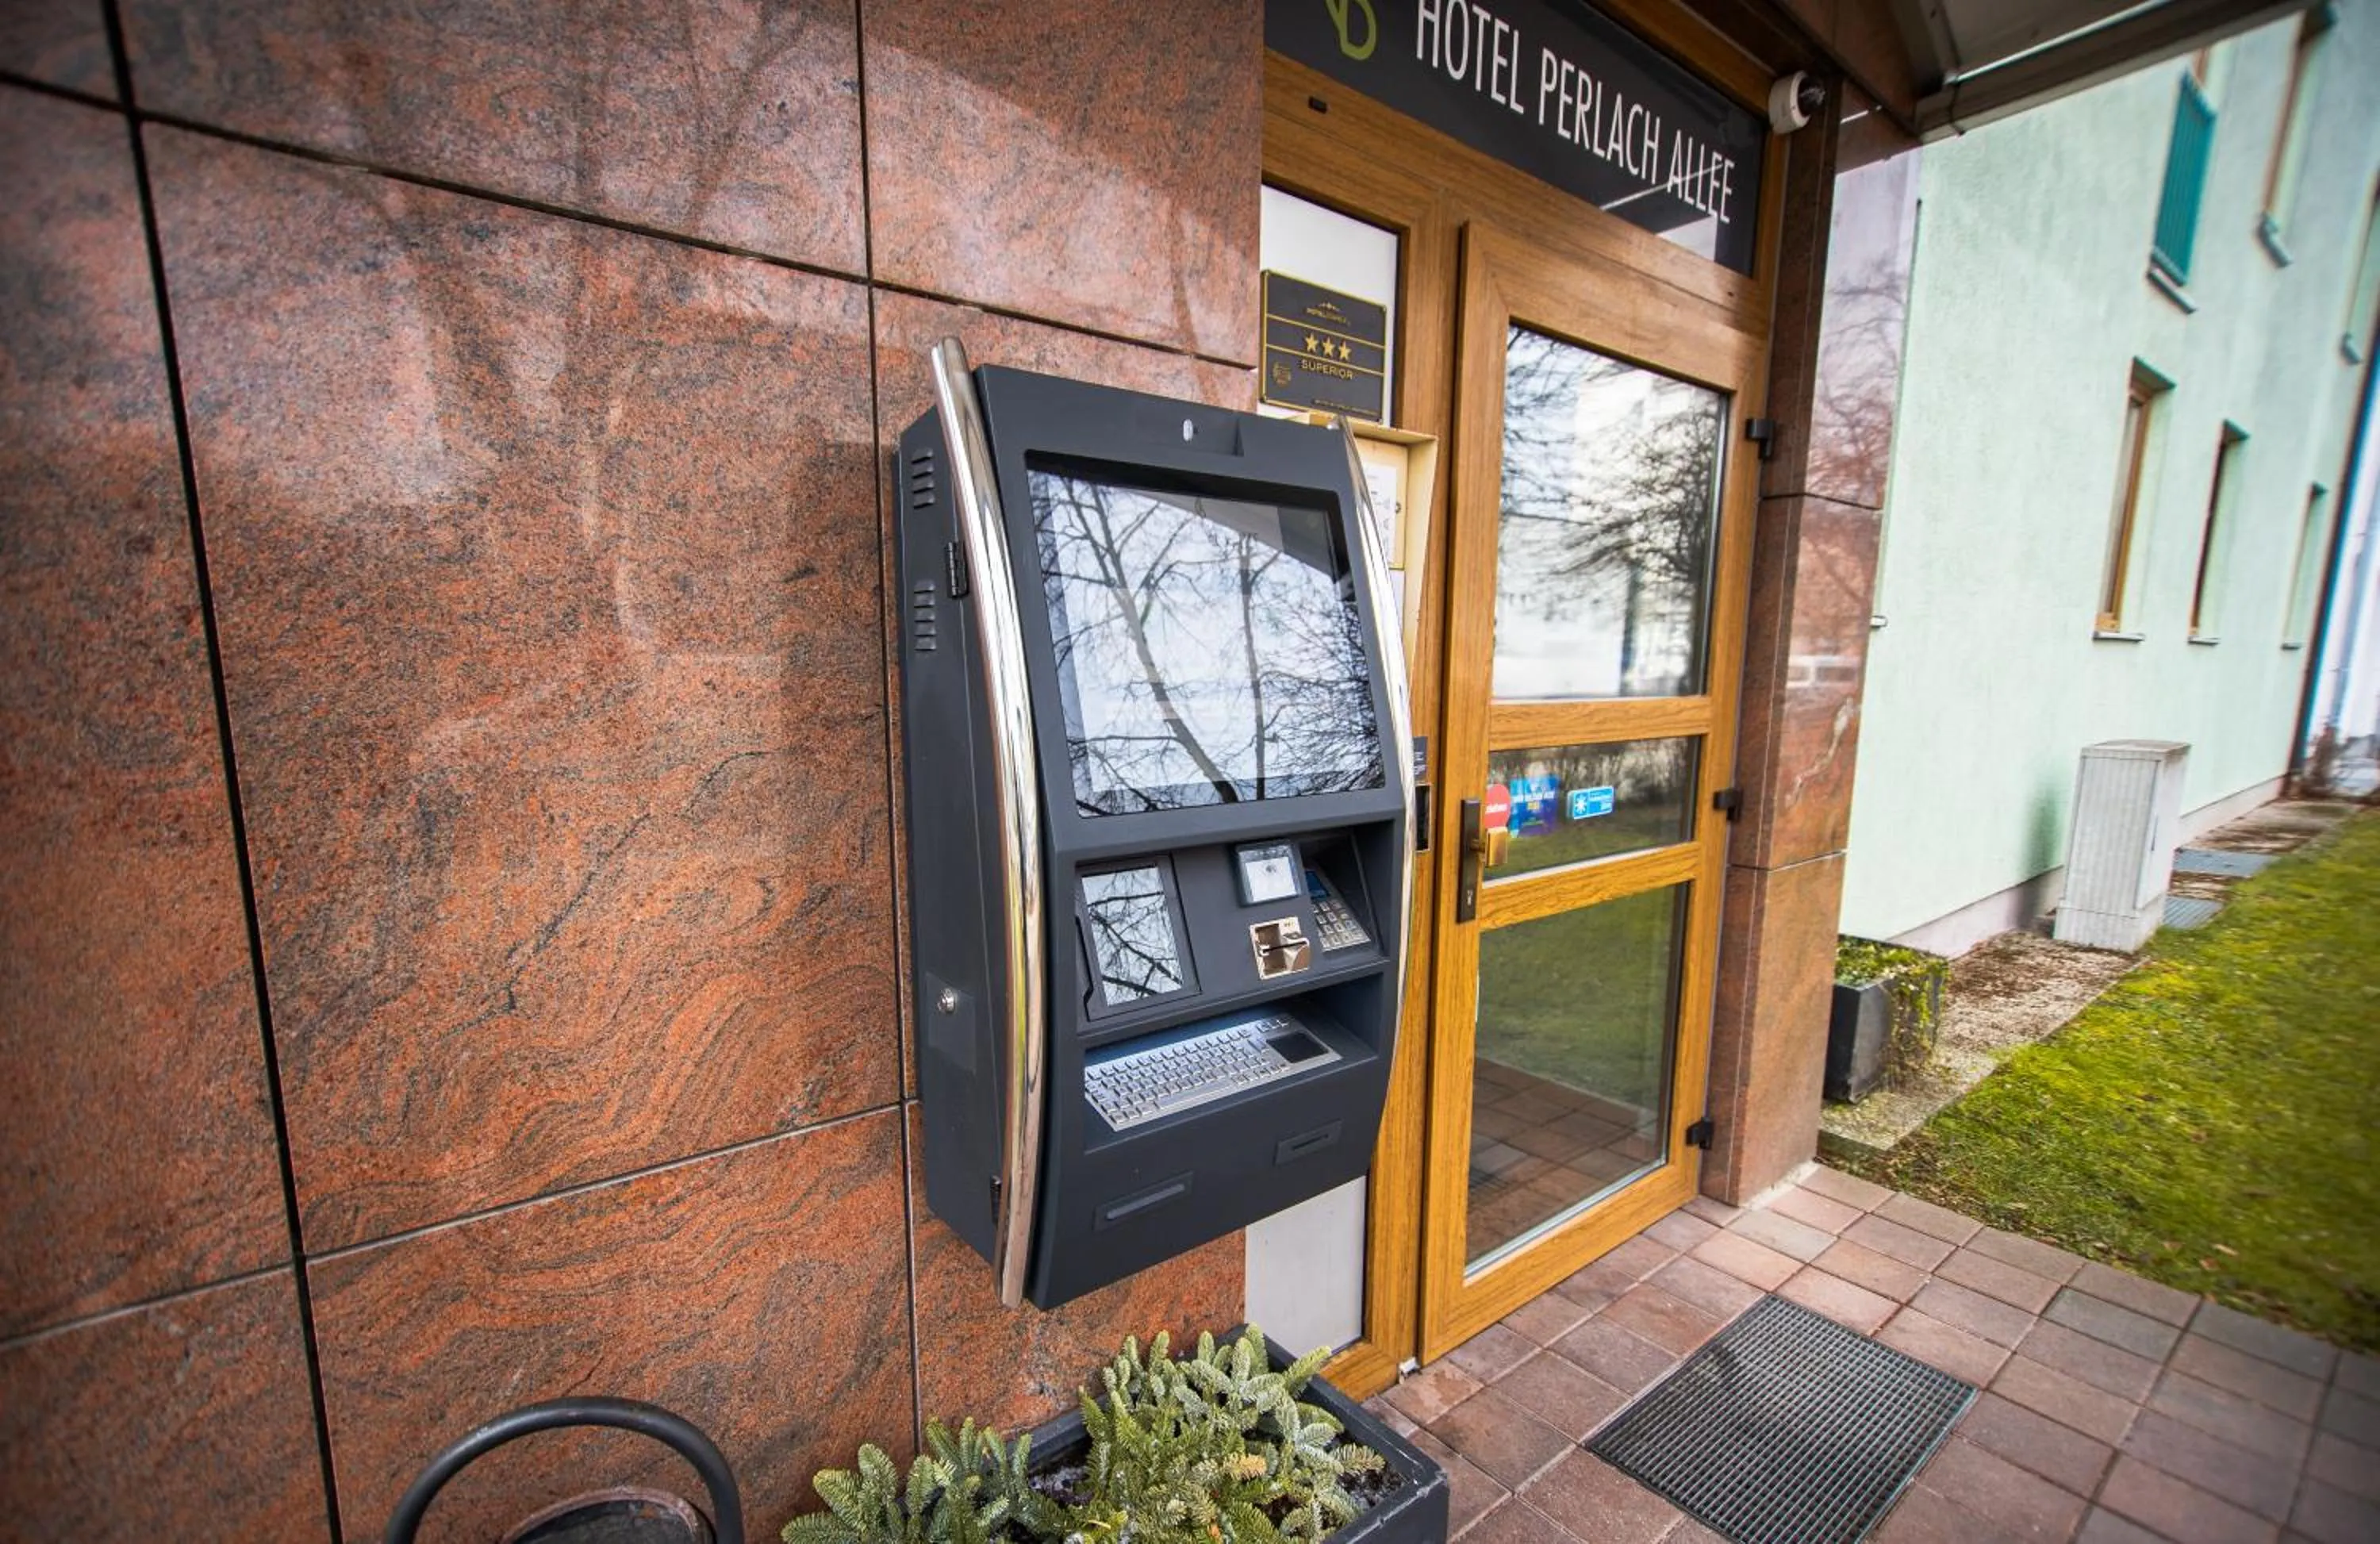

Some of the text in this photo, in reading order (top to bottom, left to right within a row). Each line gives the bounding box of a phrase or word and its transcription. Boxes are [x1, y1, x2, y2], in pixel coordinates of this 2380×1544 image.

[1417, 0, 1735, 224] HOTEL PERLACH ALLEE
[1301, 359, 1353, 380] SUPERIOR
